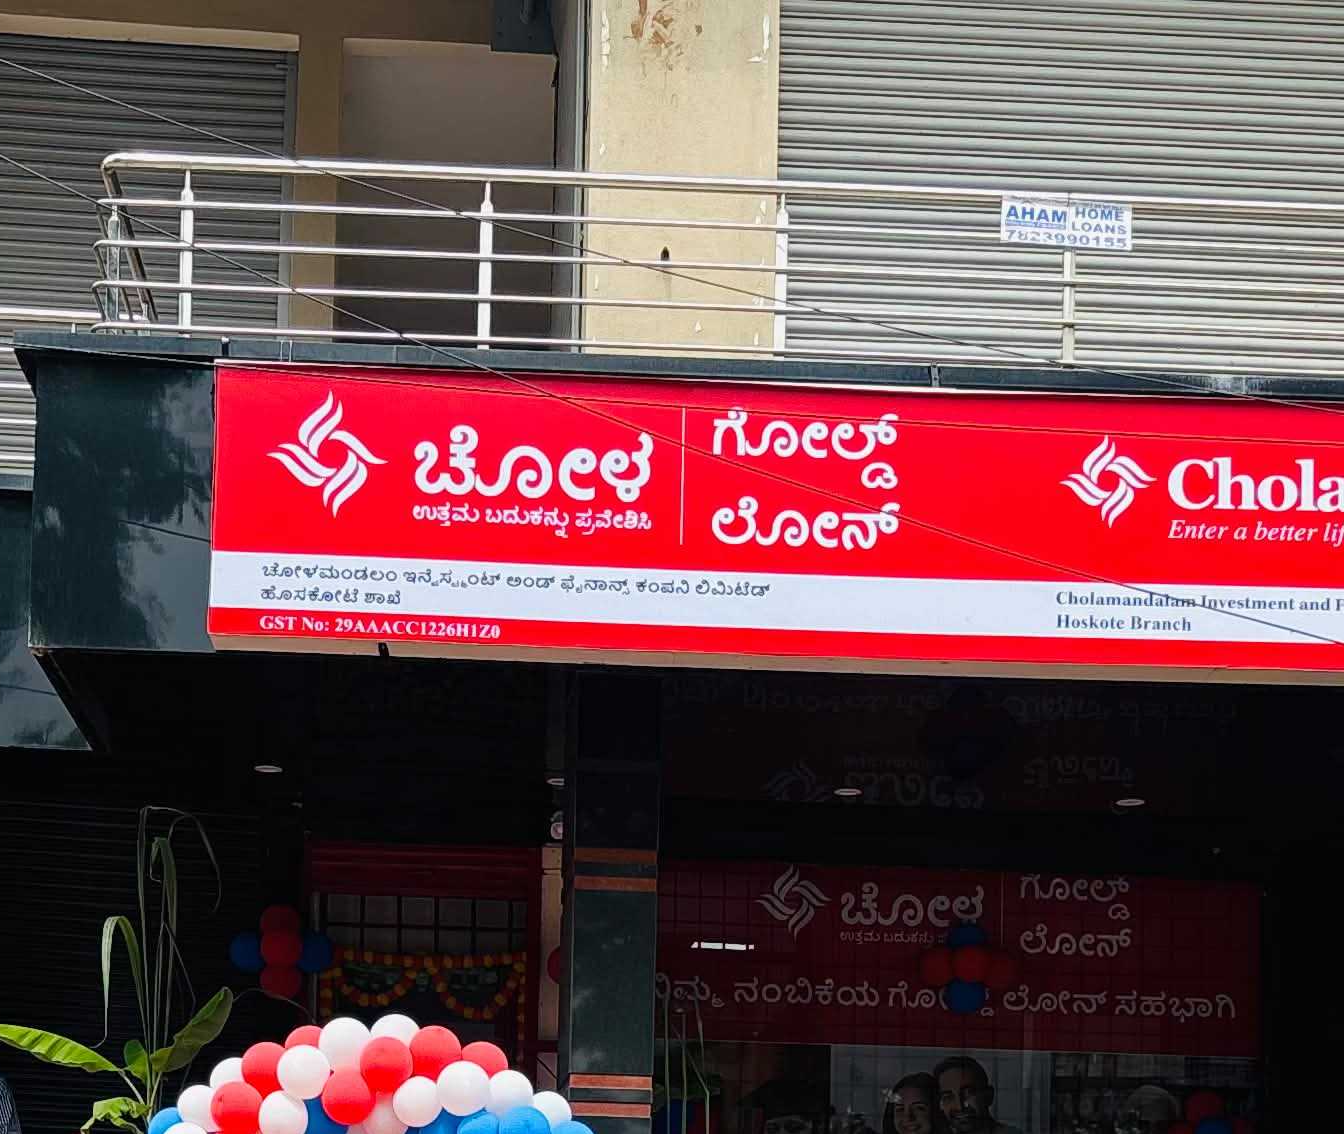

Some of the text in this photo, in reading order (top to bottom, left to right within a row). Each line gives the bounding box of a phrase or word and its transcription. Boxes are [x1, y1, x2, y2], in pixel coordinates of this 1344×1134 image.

[1006, 205, 1125, 223] AHAM HOME
[1071, 221, 1127, 235] LOANS
[712, 406, 899, 490] ಗೋಲ್ಡ್
[414, 424, 654, 503] ಚೋಳ
[412, 502, 480, 527] ಉತ್ತಮ
[485, 505, 570, 538] ಬದುಕನ್ನು
[711, 495, 901, 552] ಲೋನ್
[1167, 519, 1229, 540] Enter
[1233, 526, 1248, 540] a
[1253, 521, 1318, 542] better
[1055, 591, 1196, 608] Cholamandalam
[1201, 595, 1295, 610] Investment
[1298, 598, 1331, 611] and
[259, 615, 297, 631] GST
[302, 617, 330, 632] No:
[1055, 614, 1192, 632] Hoskote Branch
